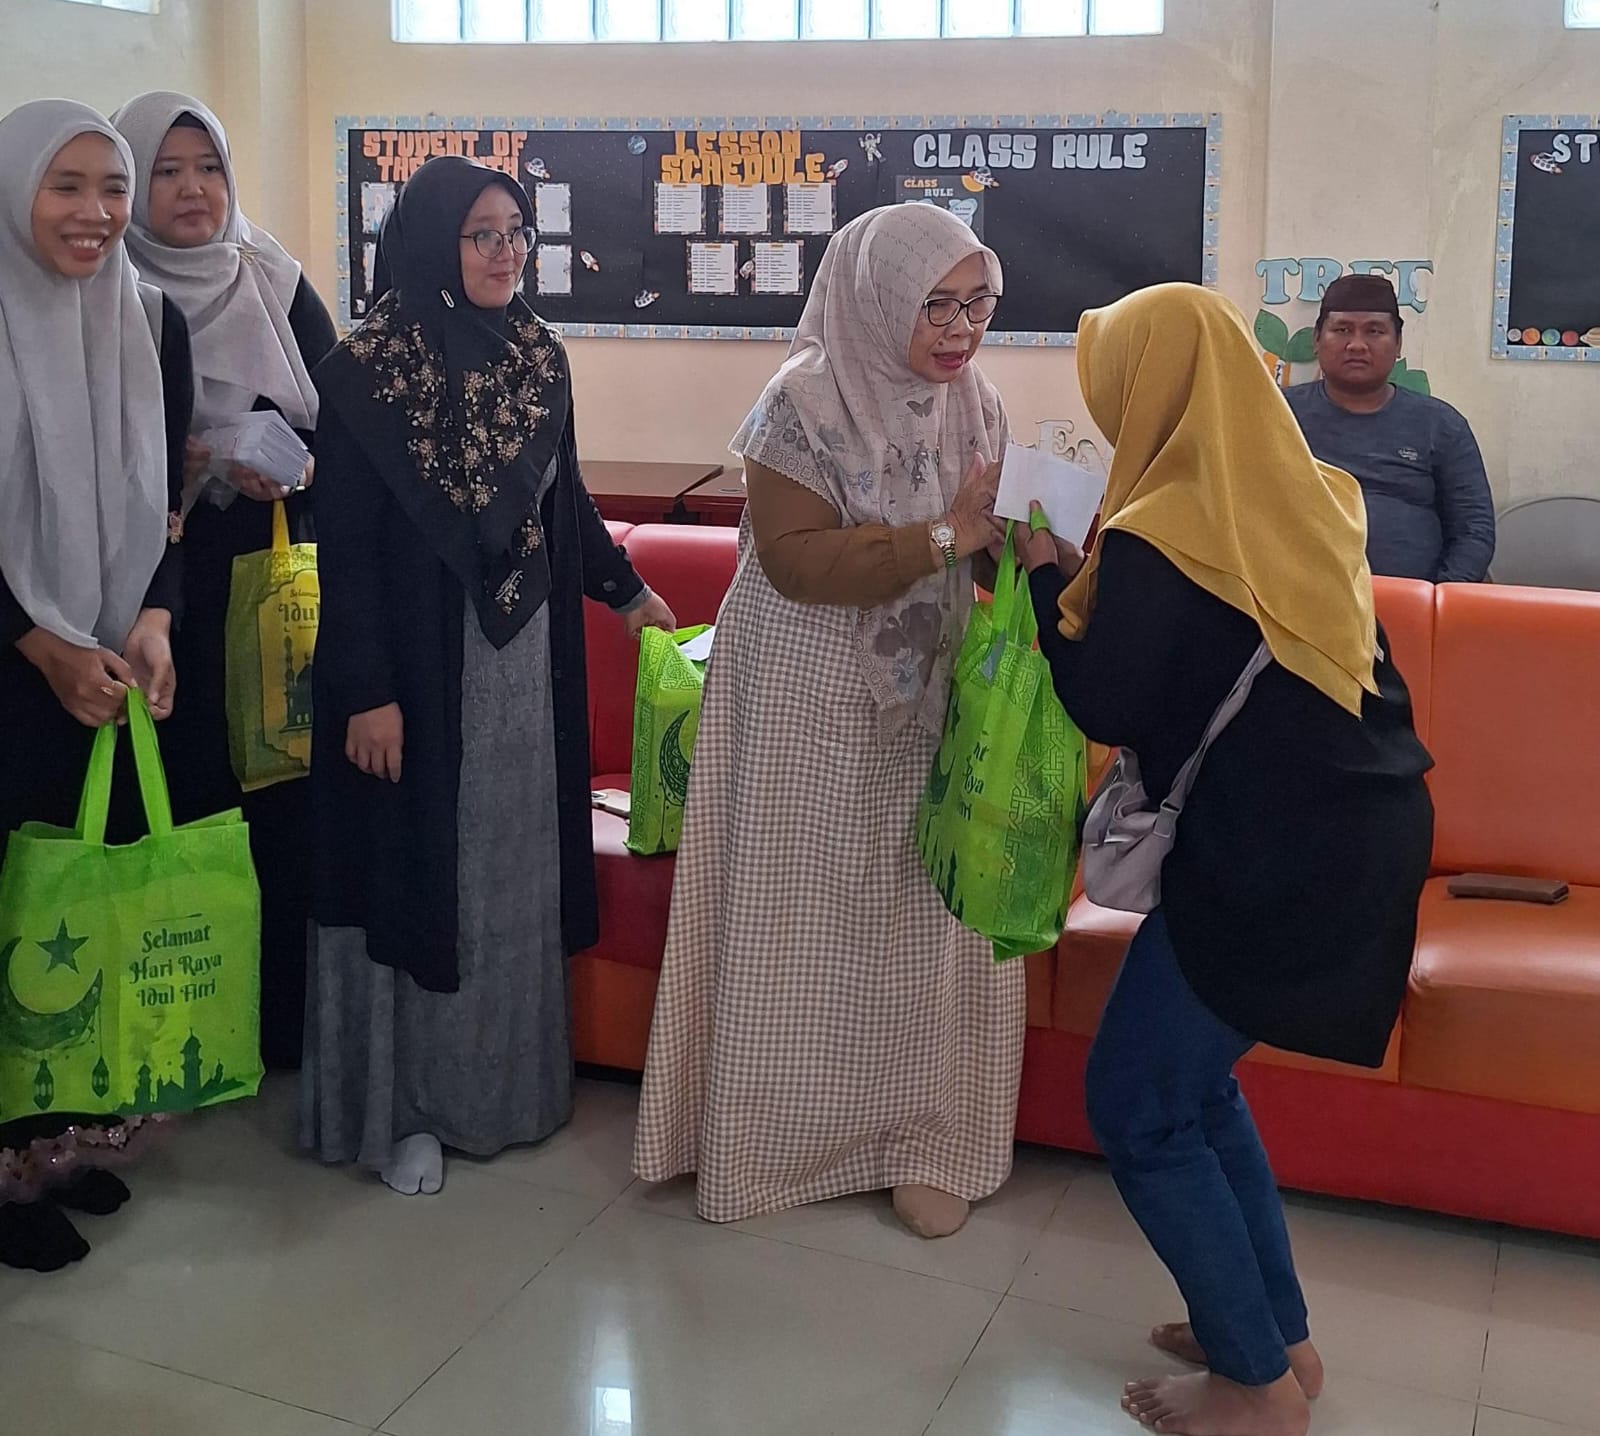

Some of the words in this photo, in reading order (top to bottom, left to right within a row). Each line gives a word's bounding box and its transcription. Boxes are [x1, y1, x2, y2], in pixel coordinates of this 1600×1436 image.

[363, 131, 479, 157] STUDENT
[492, 131, 528, 157] OF
[674, 131, 801, 158] LESSON
[912, 133, 1037, 169] CLASS
[1051, 132, 1149, 169] RULE
[1551, 133, 1600, 163] ST
[661, 152, 825, 186] SCHEDULE
[903, 178, 938, 189] CLASS
[924, 188, 954, 197] RULE
[142, 924, 211, 953] Selamat
[129, 956, 172, 984] Hari
[178, 954, 222, 976] Raya
[136, 985, 175, 1007] Idul
[180, 978, 216, 1002] Fitri
